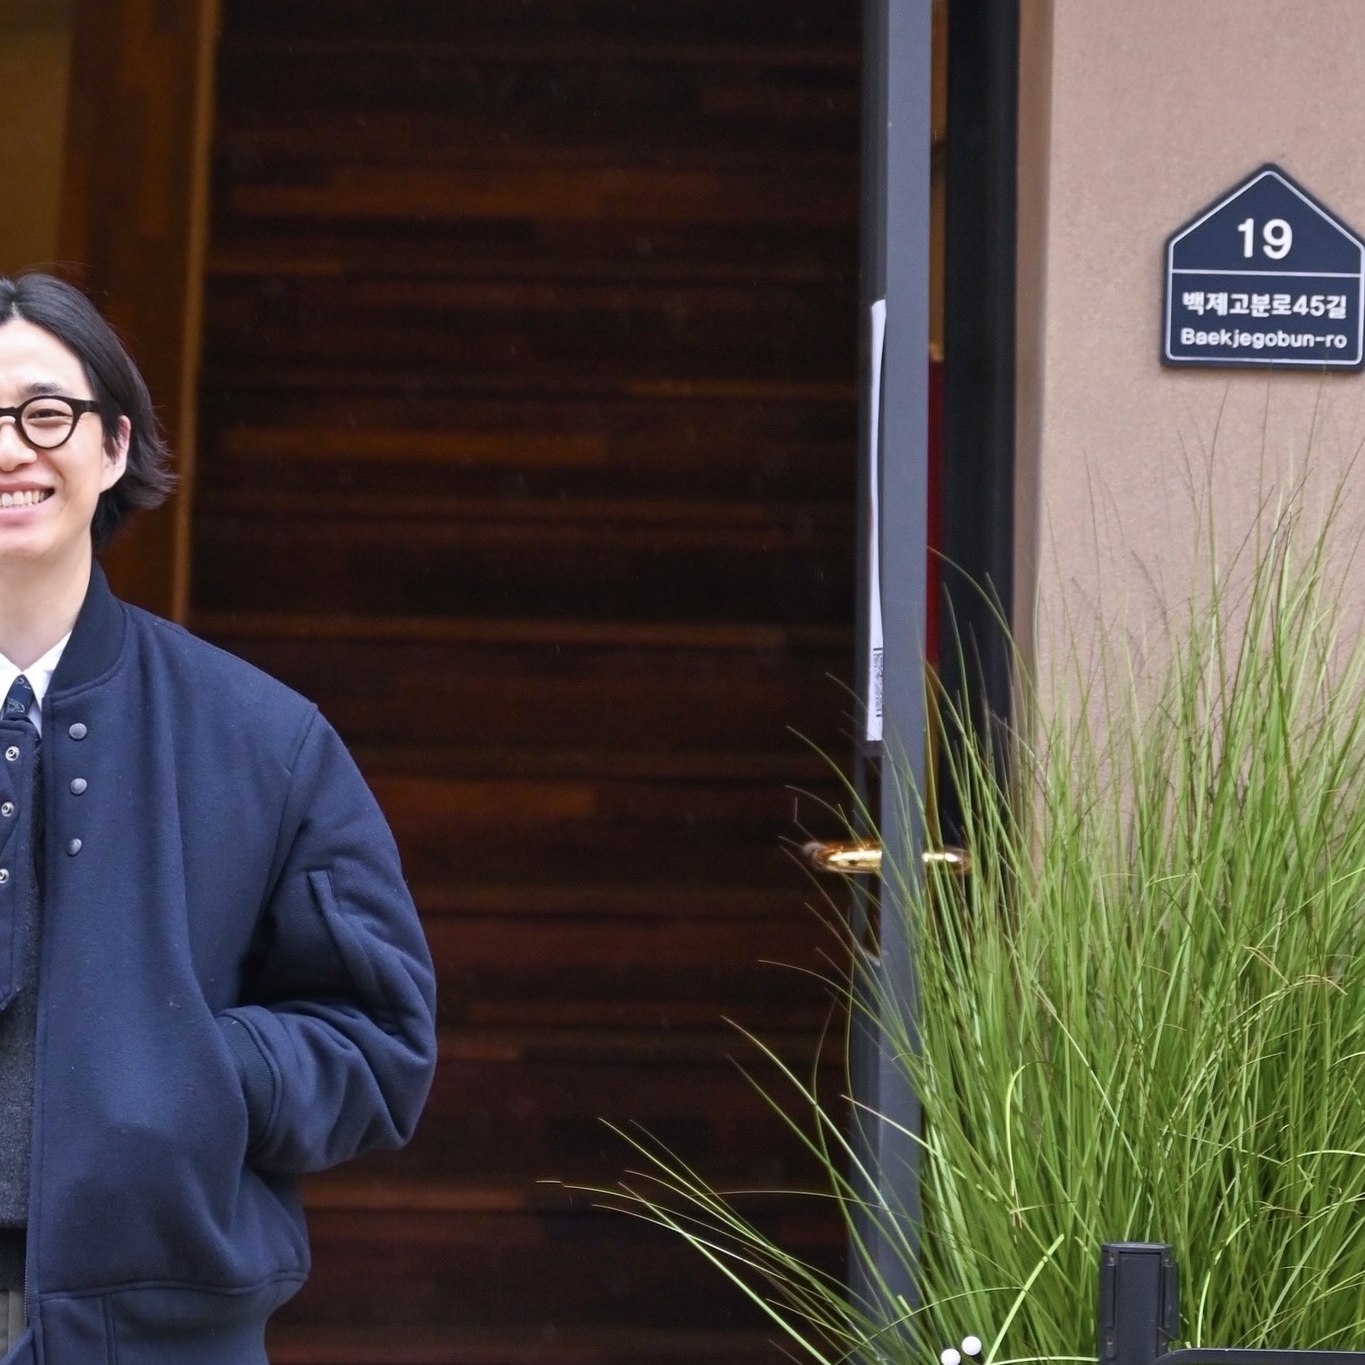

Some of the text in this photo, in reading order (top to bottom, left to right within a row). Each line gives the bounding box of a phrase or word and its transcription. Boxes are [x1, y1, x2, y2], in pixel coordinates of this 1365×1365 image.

[1237, 218, 1293, 260] 19
[1182, 291, 1347, 319] 백제고분로45길
[1180, 327, 1348, 349] Baekjegobun-ro
